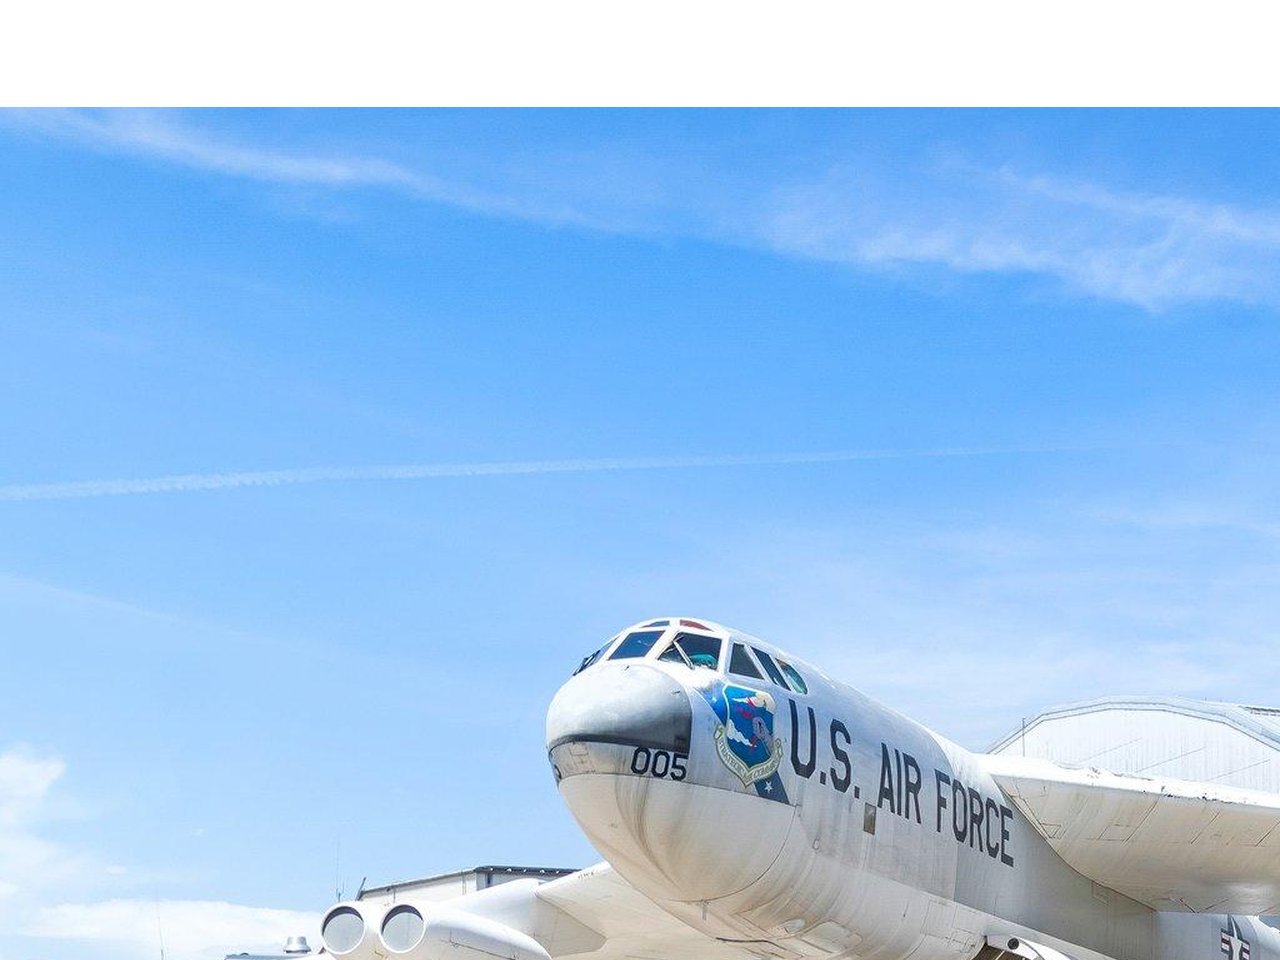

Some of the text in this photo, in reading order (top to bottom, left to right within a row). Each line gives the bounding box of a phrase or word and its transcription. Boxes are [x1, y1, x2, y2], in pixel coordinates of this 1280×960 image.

[630, 746, 689, 782] 005
[788, 699, 1014, 868] U.S. AIR FORCE
